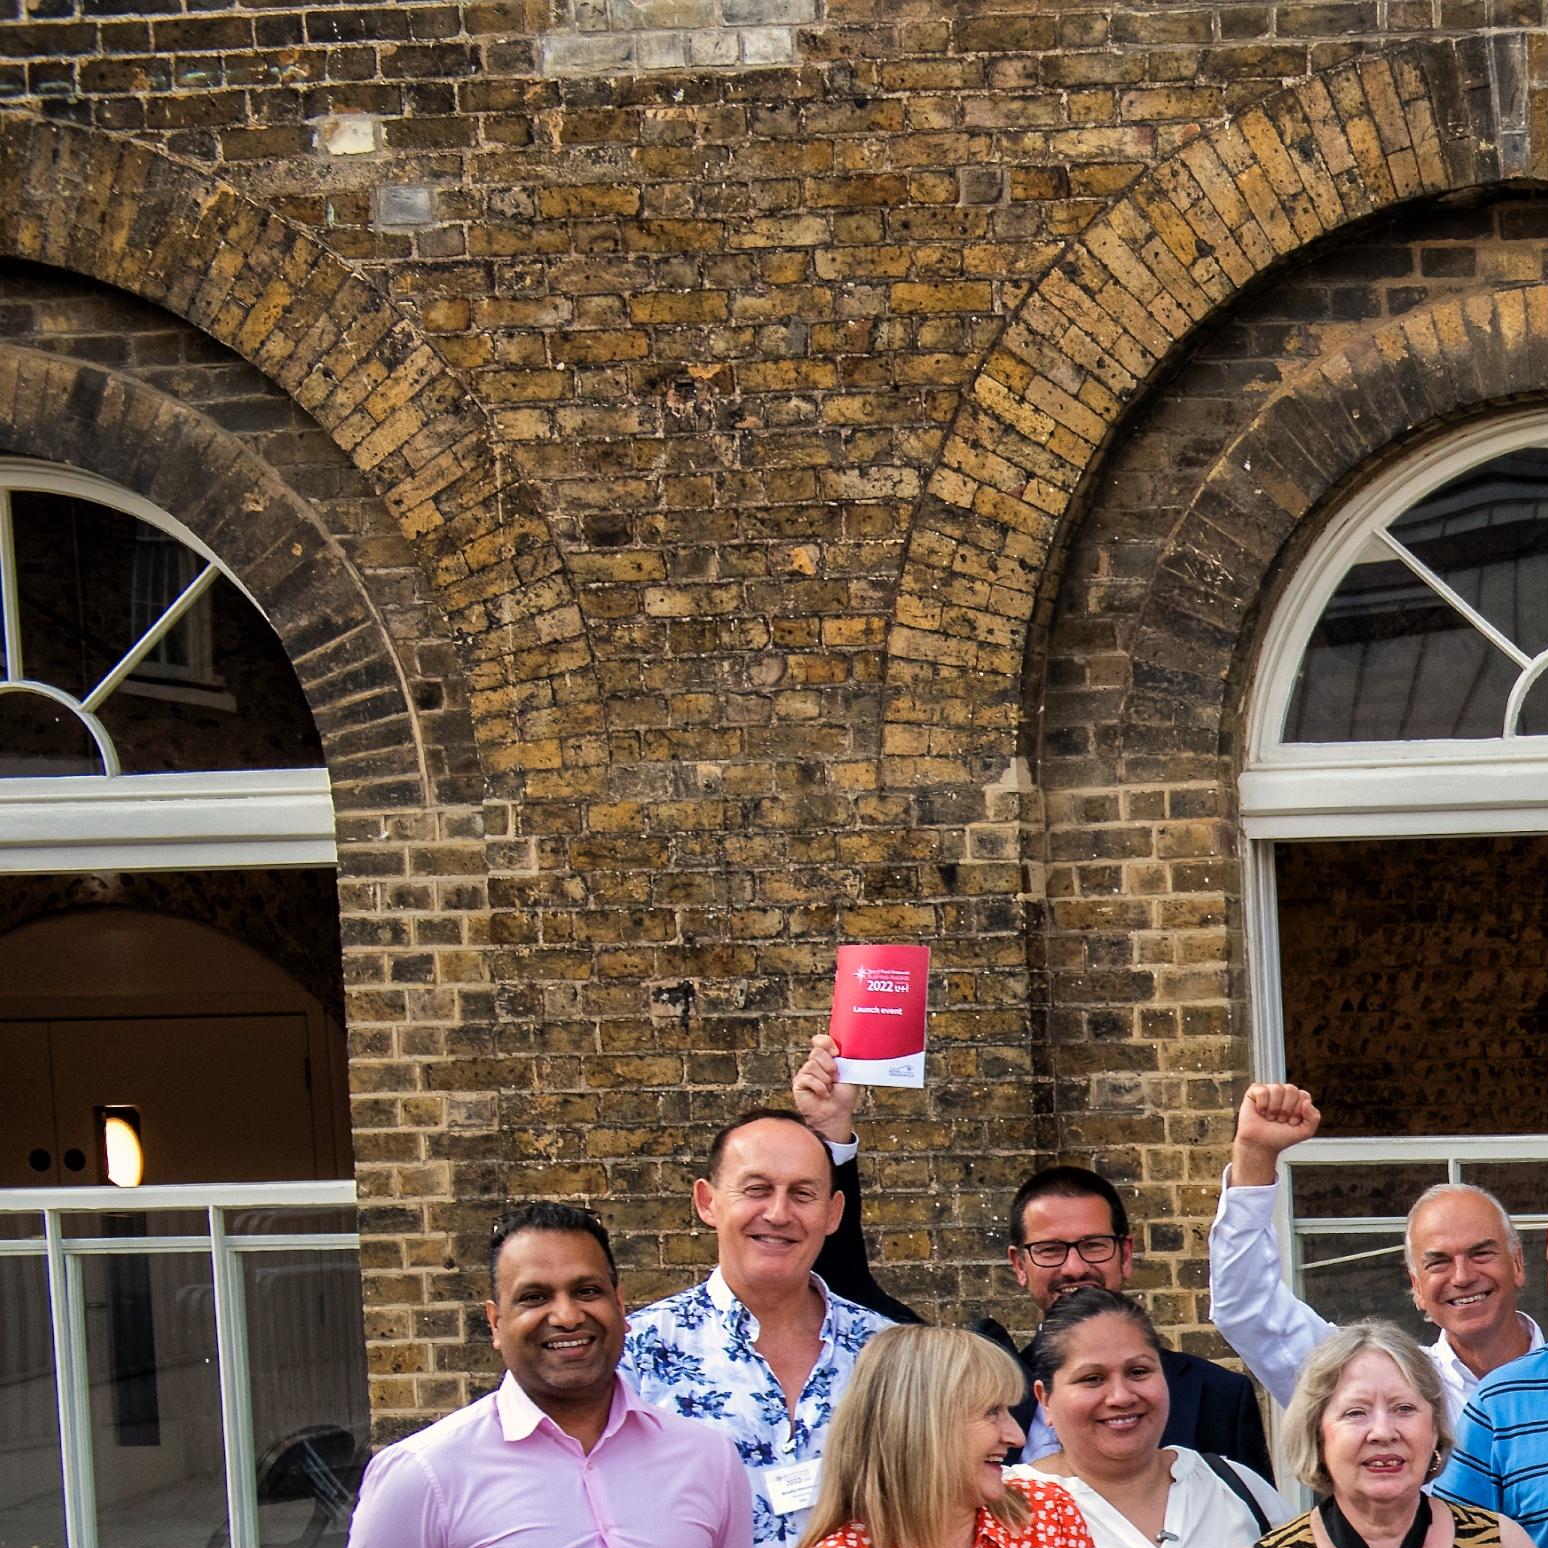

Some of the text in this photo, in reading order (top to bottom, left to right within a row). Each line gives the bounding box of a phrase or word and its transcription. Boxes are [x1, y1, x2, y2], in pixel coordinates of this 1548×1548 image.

[867, 980, 893, 992] 2022
[852, 1006, 903, 1016] Launch event
